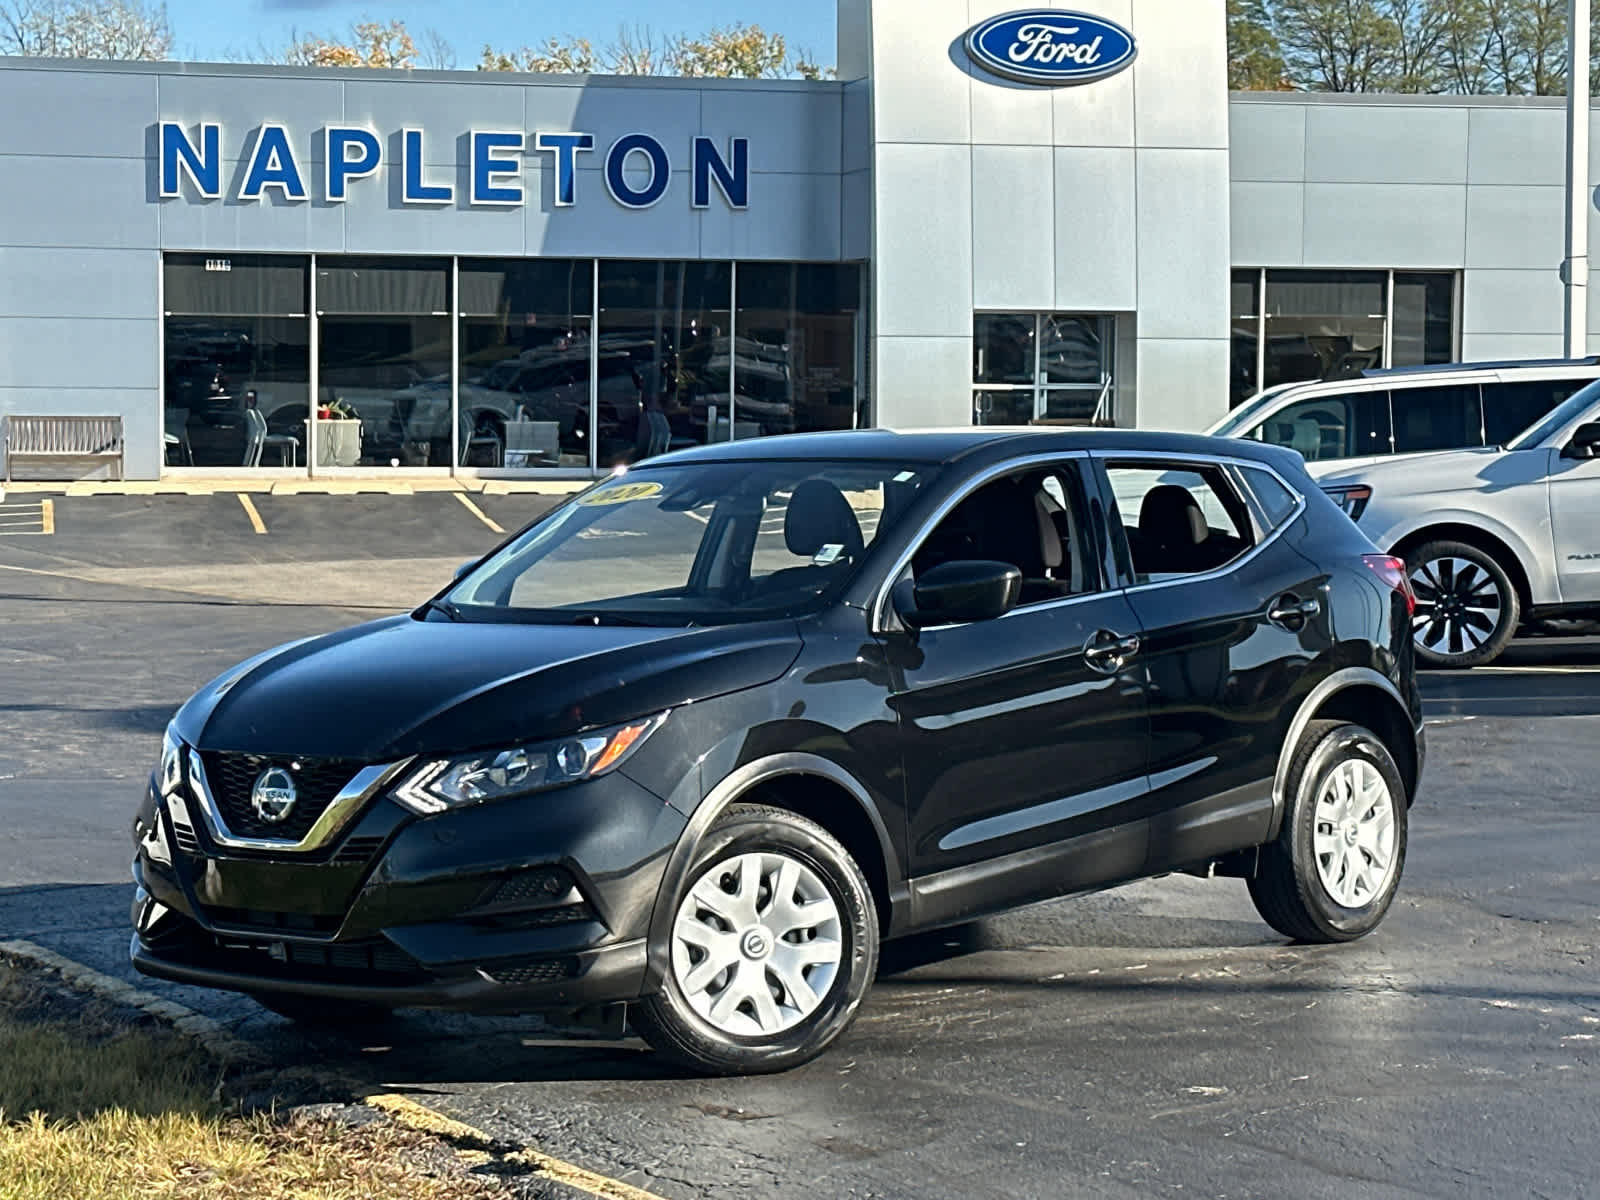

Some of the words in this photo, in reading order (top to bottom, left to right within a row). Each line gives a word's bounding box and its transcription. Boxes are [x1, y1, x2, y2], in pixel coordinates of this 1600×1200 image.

[1008, 23, 1103, 64] Ford
[158, 120, 749, 209] NAPLETON
[257, 790, 290, 800] NISSAN
